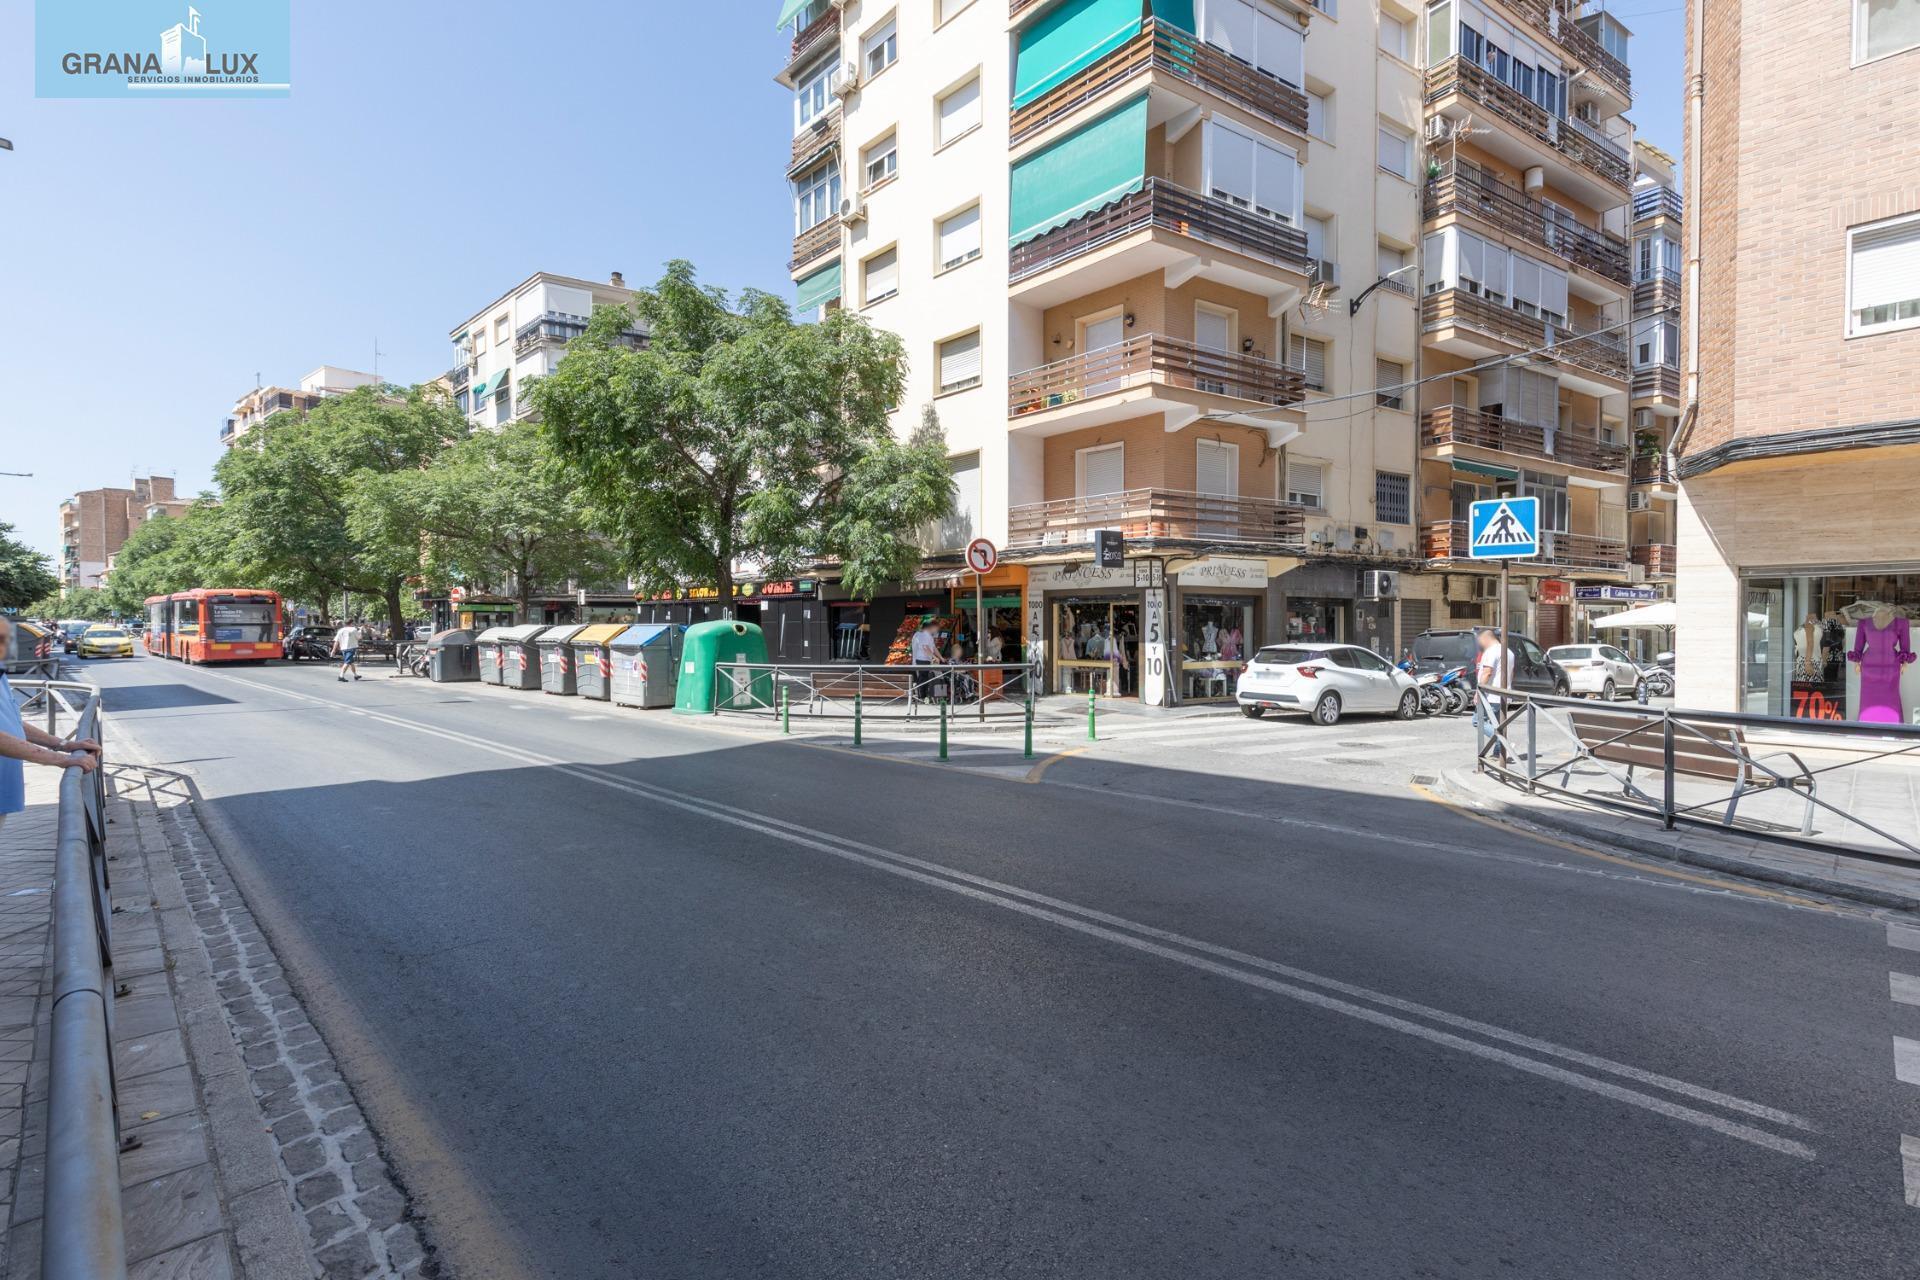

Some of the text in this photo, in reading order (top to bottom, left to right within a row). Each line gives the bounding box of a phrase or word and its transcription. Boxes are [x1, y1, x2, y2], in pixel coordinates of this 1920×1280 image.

[1052, 566, 1114, 581] PRINCESS
[1200, 566, 1247, 579] PRINCESS
[1147, 601, 1162, 609] TOO
[1152, 610, 1157, 619] A
[1150, 622, 1158, 642] 5
[1152, 646, 1157, 655] Y
[1147, 658, 1162, 676] 10
[1792, 690, 1842, 720] 70%
